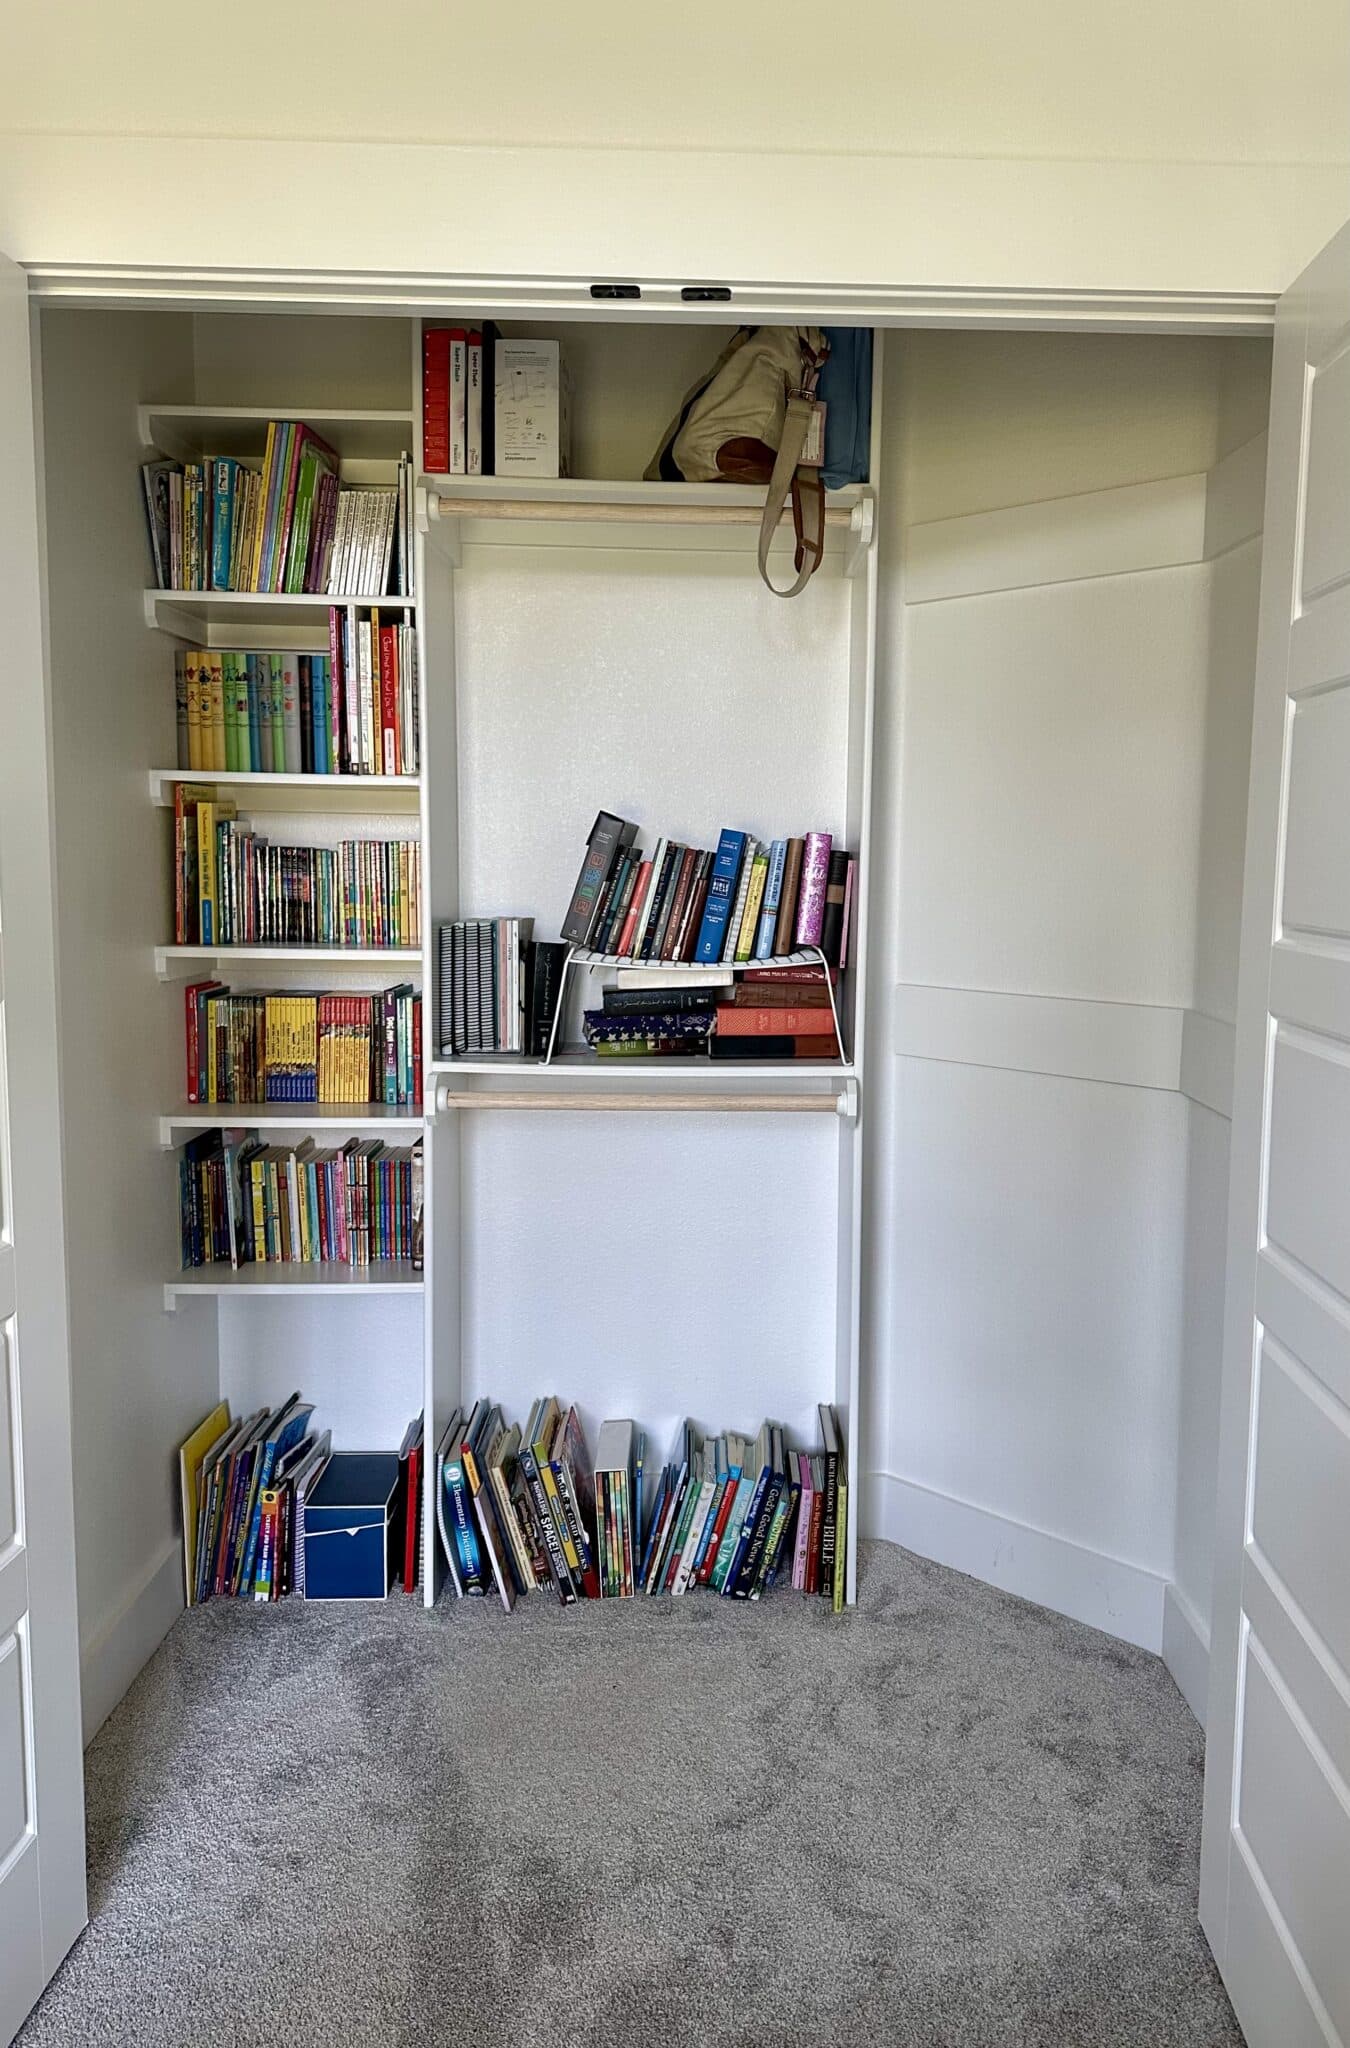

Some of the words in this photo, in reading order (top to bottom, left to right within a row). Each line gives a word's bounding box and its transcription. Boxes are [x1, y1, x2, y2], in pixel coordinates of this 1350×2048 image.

[383, 636, 391, 651] God
[385, 1016, 394, 1029] DOG
[386, 1030, 394, 1041] MAN
[555, 1471, 570, 1502] MAGIC
[826, 1455, 836, 1512] ARCHAEOLOGY
[564, 1502, 571, 1510] &
[763, 1487, 779, 1513] God's
[450, 1483, 467, 1530] Elementary
[460, 1530, 477, 1573] Dictionary
[532, 1480, 548, 1516] KNOWLEDGE
[540, 1516, 559, 1552] SPACE!
[567, 1512, 579, 1537] CARD
[755, 1513, 771, 1538] Good
[764, 1513, 785, 1555] DEVOTIONS
[821, 1525, 835, 1564] BIBLE
[574, 1537, 588, 1570] TRICKS
[747, 1538, 762, 1564] News
